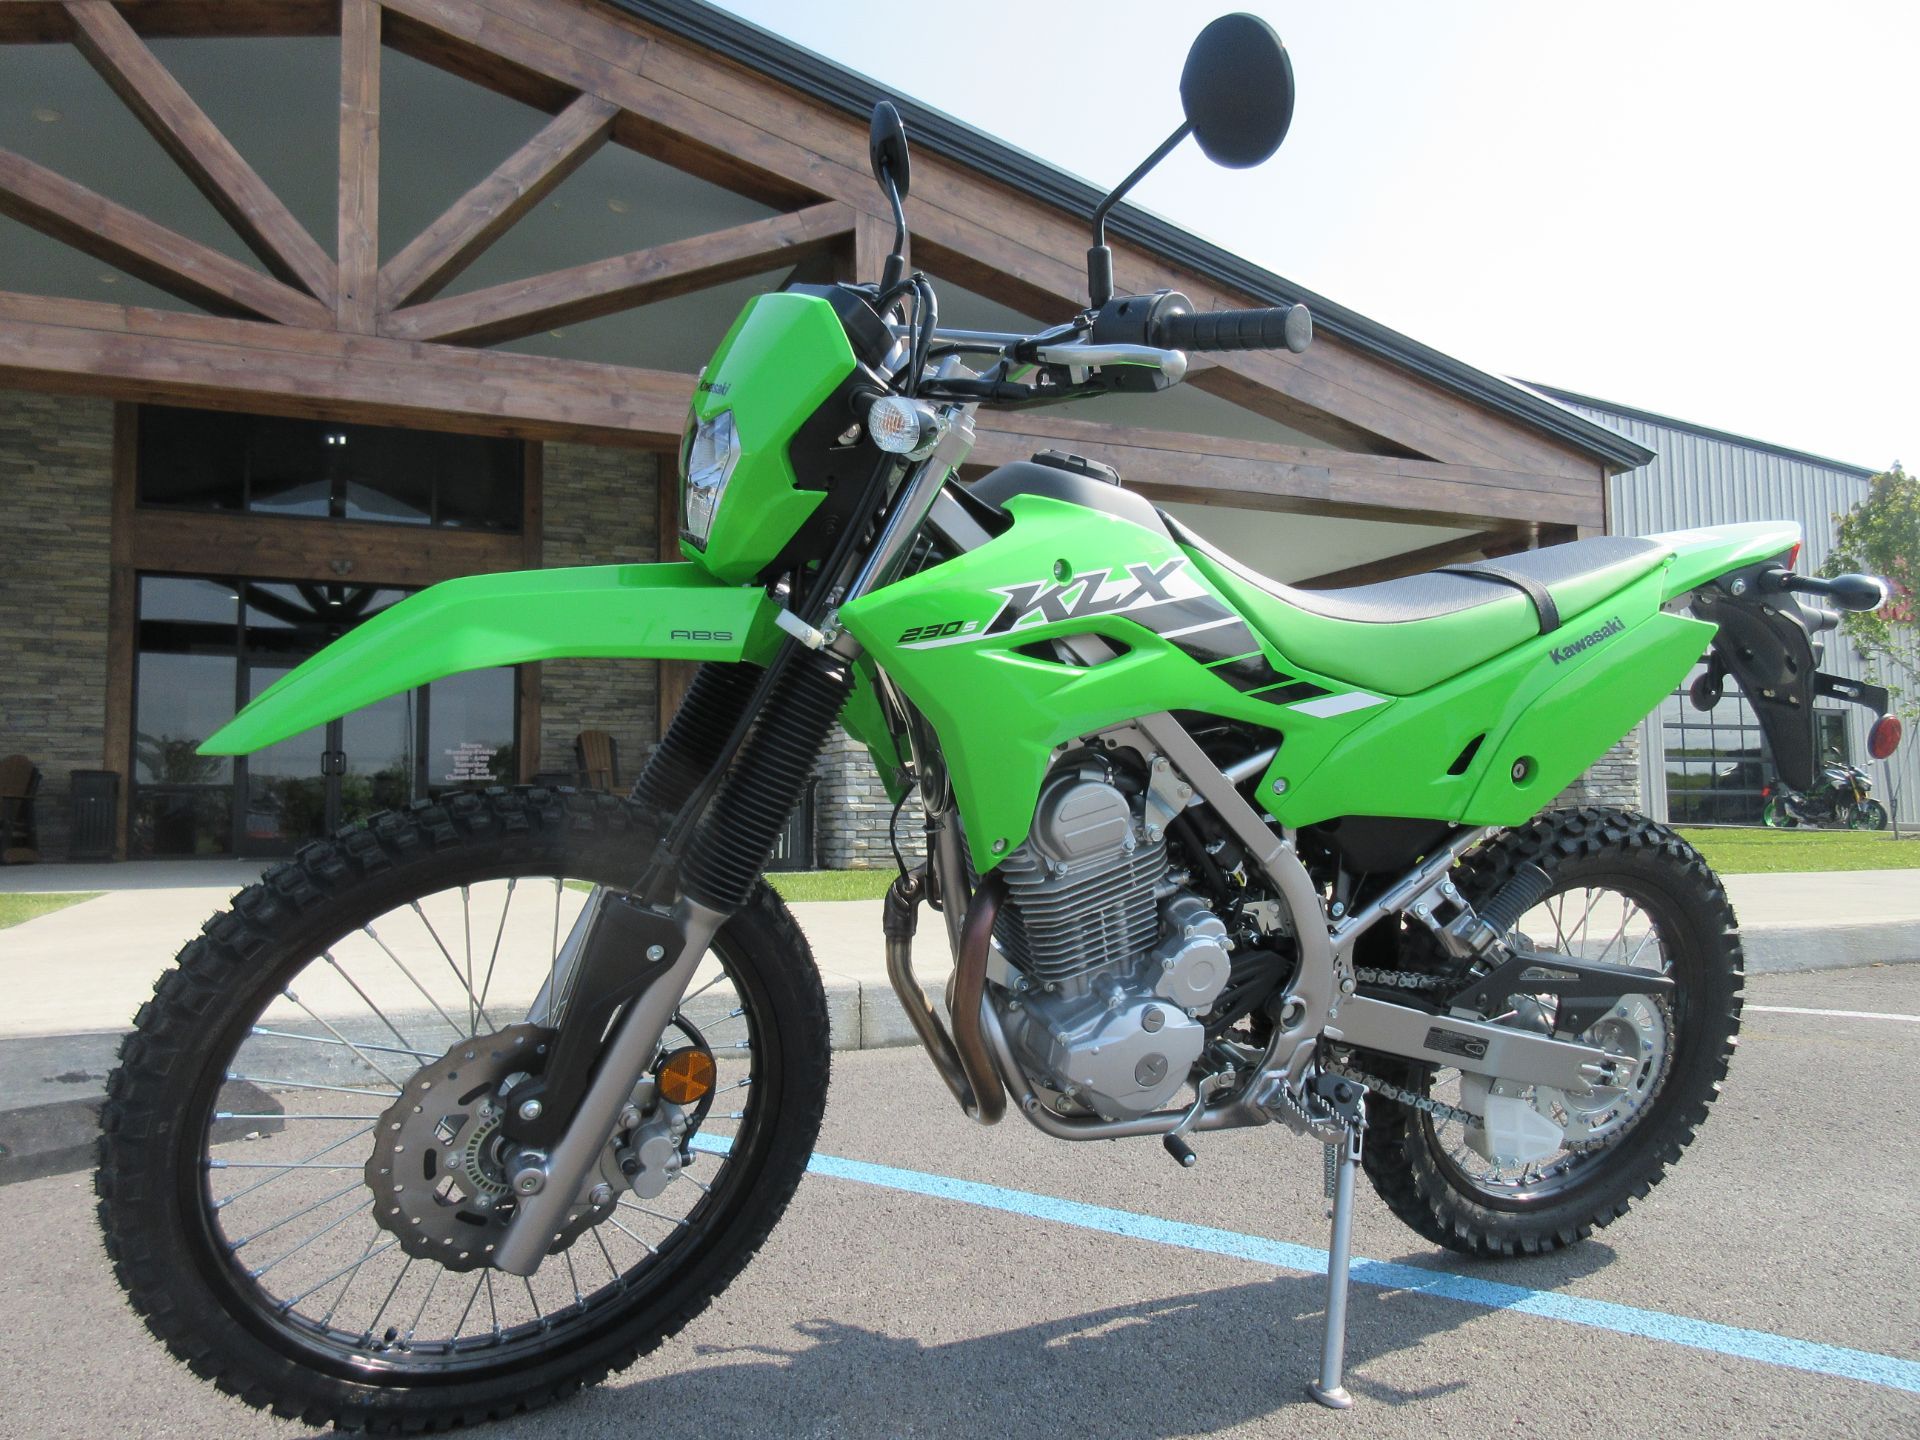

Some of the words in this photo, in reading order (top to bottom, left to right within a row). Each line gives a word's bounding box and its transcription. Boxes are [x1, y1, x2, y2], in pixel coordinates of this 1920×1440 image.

[981, 558, 1188, 636] KLX
[670, 630, 733, 641] ABS
[1549, 616, 1626, 665] Kawasaki
